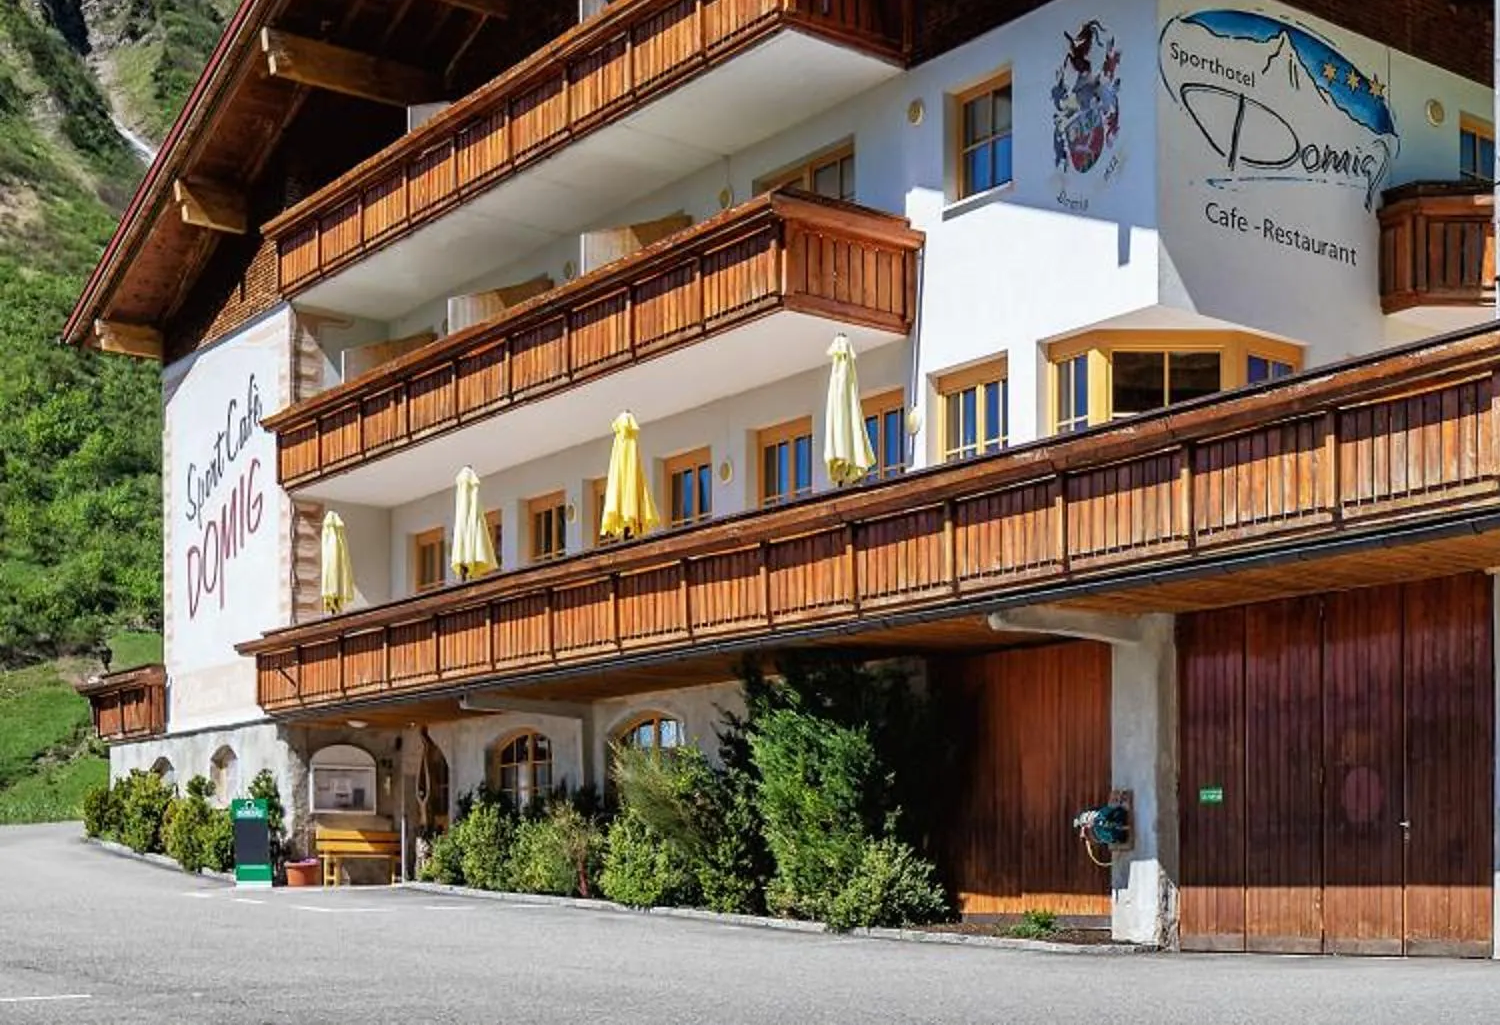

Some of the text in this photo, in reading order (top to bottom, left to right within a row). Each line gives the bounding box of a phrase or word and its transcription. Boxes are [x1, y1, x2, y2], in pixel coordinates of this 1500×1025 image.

[1169, 41, 1256, 88] Sporthotel
[1179, 82, 1390, 213] Domig
[1205, 202, 1248, 233] Cafe
[185, 431, 226, 532] Sport
[186, 457, 263, 619] DOMIG
